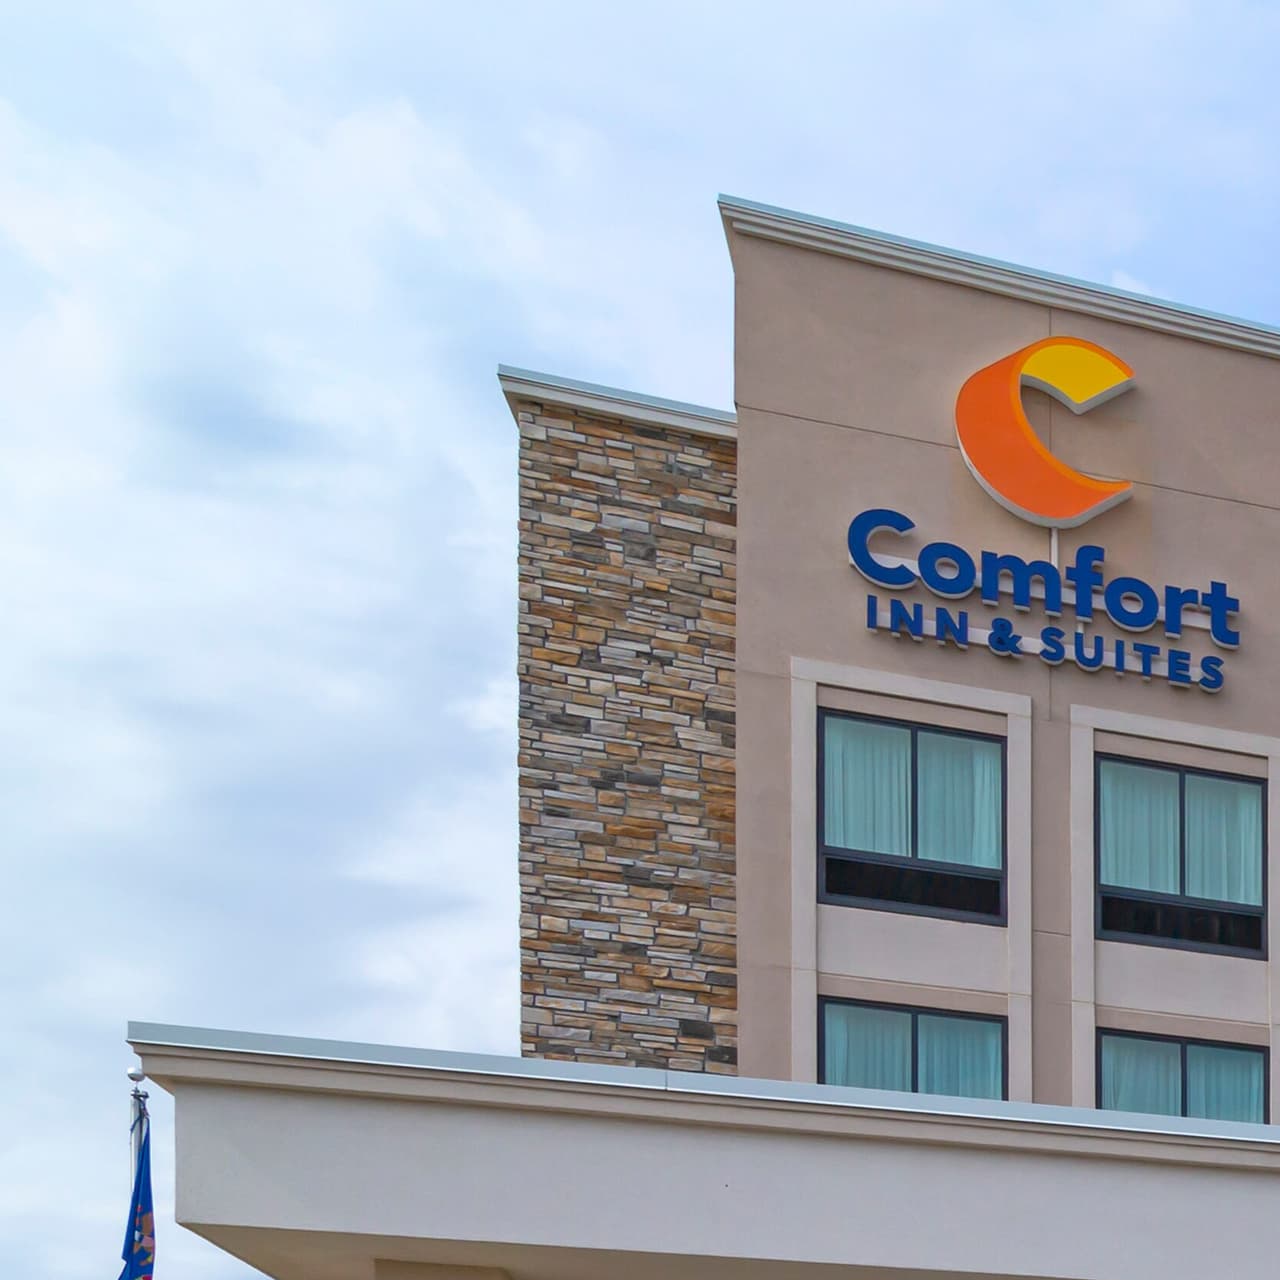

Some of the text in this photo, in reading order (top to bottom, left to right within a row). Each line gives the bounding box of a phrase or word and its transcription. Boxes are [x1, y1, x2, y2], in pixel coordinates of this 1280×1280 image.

[847, 508, 1240, 648] Comfort
[866, 595, 1224, 692] INN & SUITES
